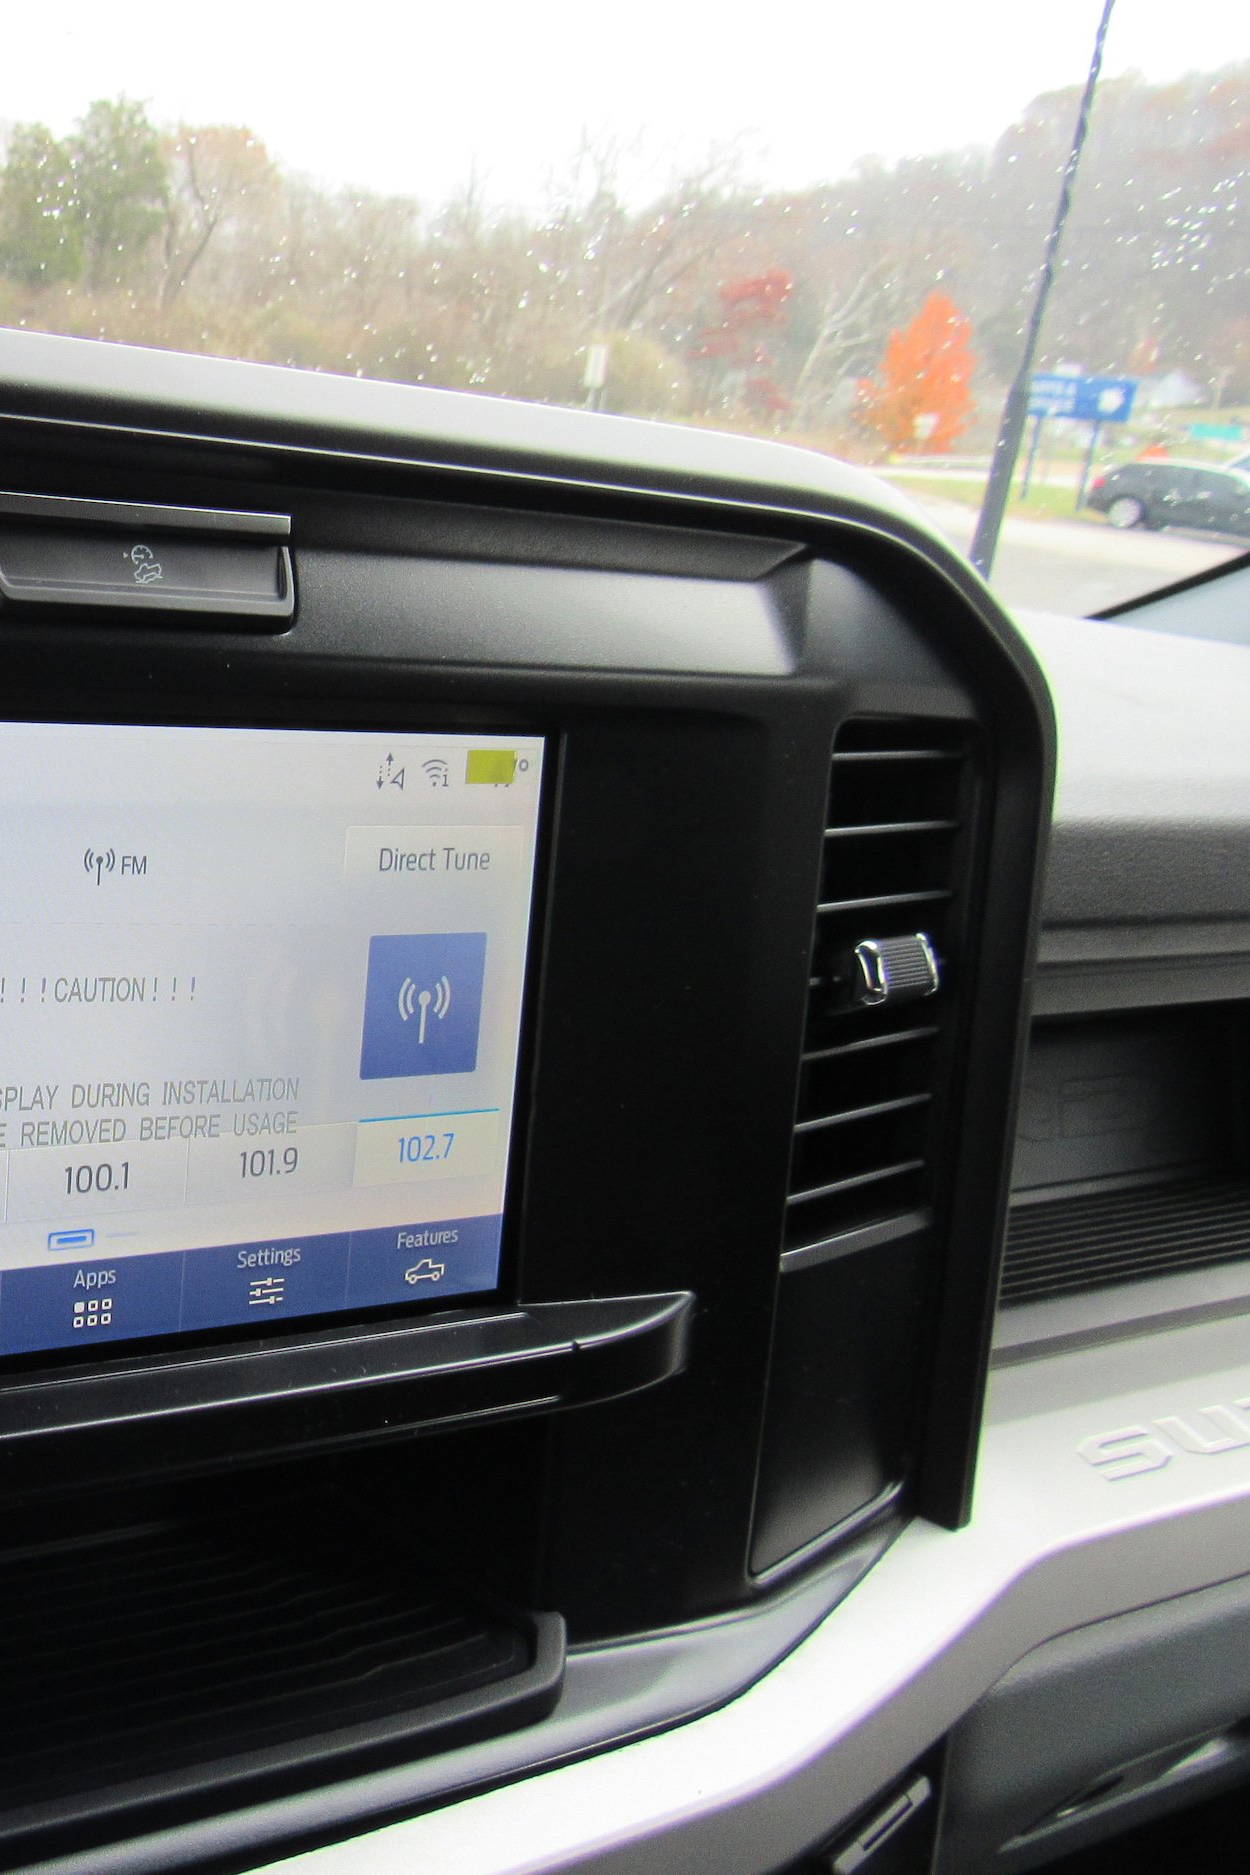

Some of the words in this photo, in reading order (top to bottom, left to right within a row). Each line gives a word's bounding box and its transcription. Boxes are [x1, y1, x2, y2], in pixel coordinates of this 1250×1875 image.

[121, 855, 147, 876] FM
[379, 847, 436, 872] Direct
[443, 847, 491, 871] Tune
[71, 1082, 150, 1109] DURING
[162, 1077, 300, 1106] INSTALLATION
[20, 1119, 126, 1147] REMOVED
[139, 1114, 221, 1142] BEFORE
[233, 1111, 299, 1137] USAGE
[239, 1146, 299, 1179] 101.9
[397, 1132, 455, 1163] 102.7
[64, 1162, 131, 1195] 100.1
[396, 1227, 459, 1250] Features
[237, 1245, 301, 1271] Settings
[73, 1267, 116, 1290] Apps
[1076, 1396, 1250, 1482] SU
